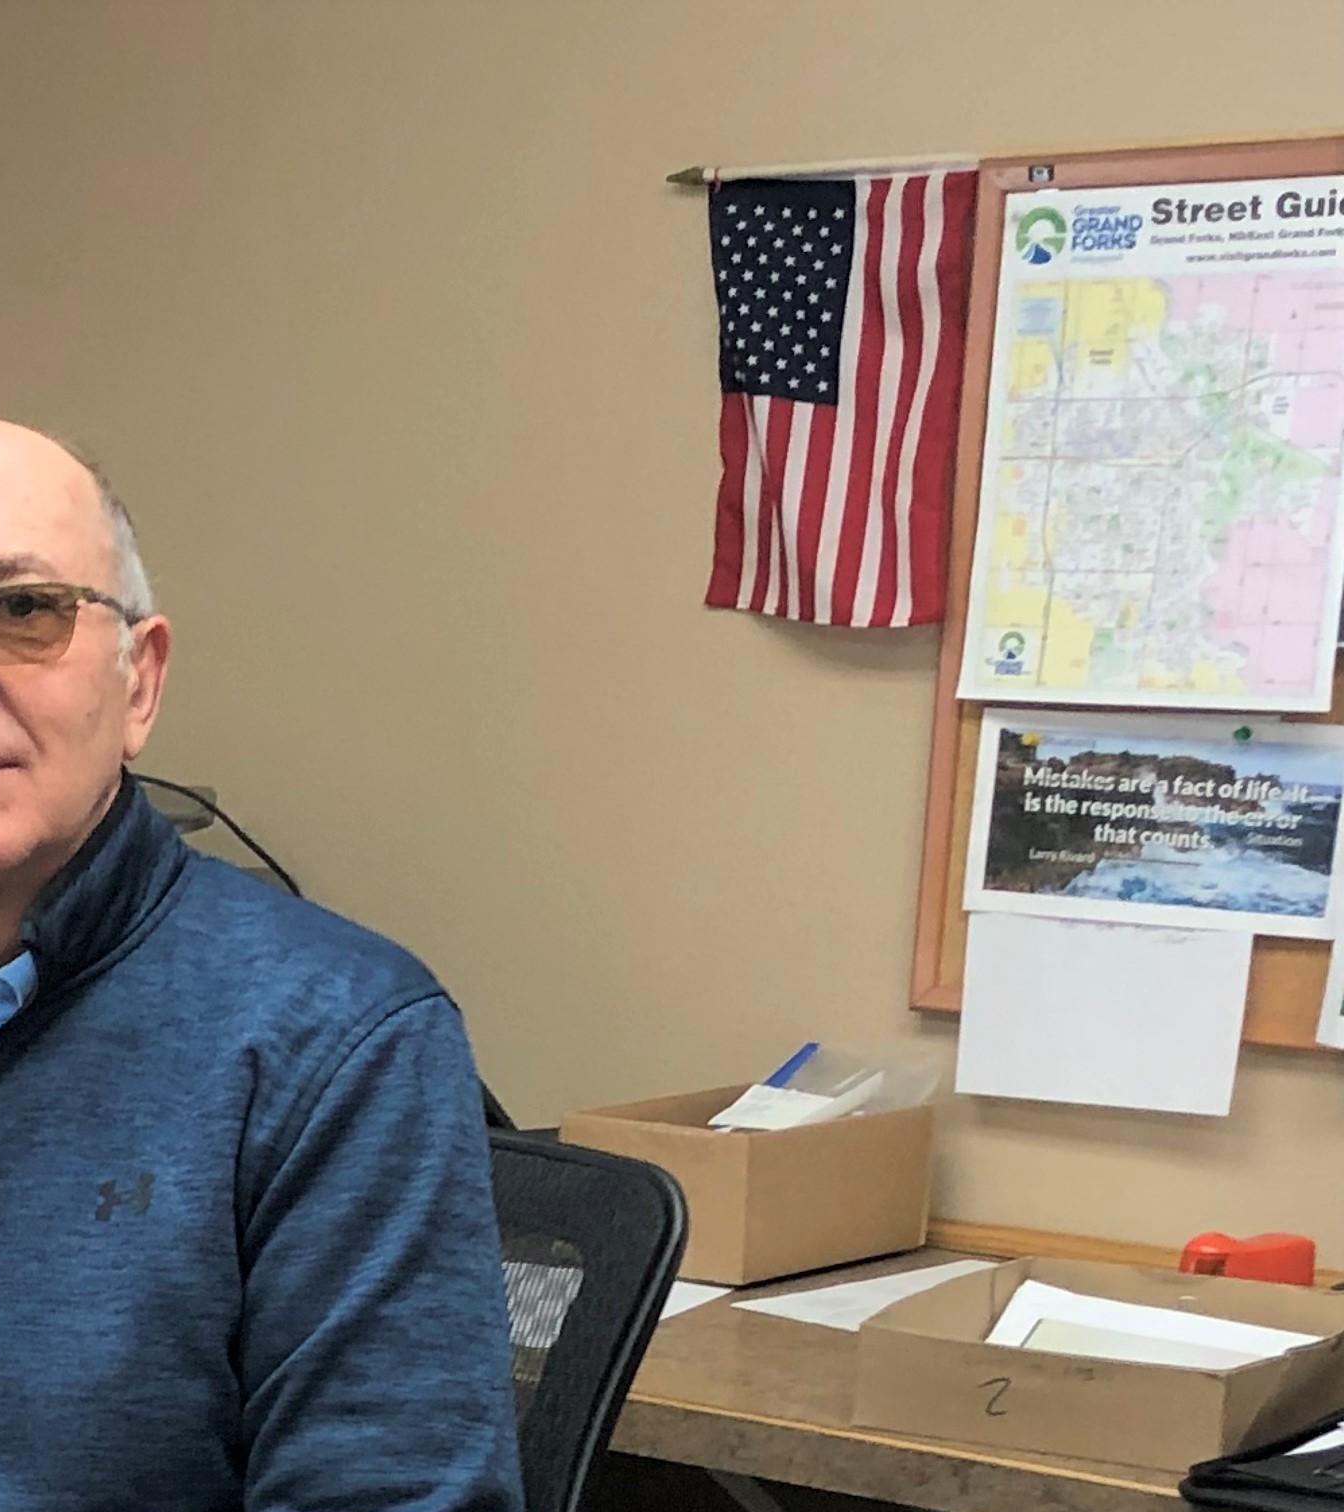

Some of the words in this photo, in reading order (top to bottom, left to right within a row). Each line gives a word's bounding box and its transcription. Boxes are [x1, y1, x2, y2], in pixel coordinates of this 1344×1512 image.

[1151, 195, 1263, 225] Street
[1072, 213, 1144, 234] GRAND
[1072, 233, 1137, 251] FORKS
[1023, 765, 1115, 791] Mistakes
[1118, 776, 1152, 793] are
[1173, 775, 1216, 798] fact
[1218, 778, 1244, 799] of
[1023, 791, 1041, 812] is
[1044, 793, 1079, 815] the
[1094, 822, 1136, 844] that
